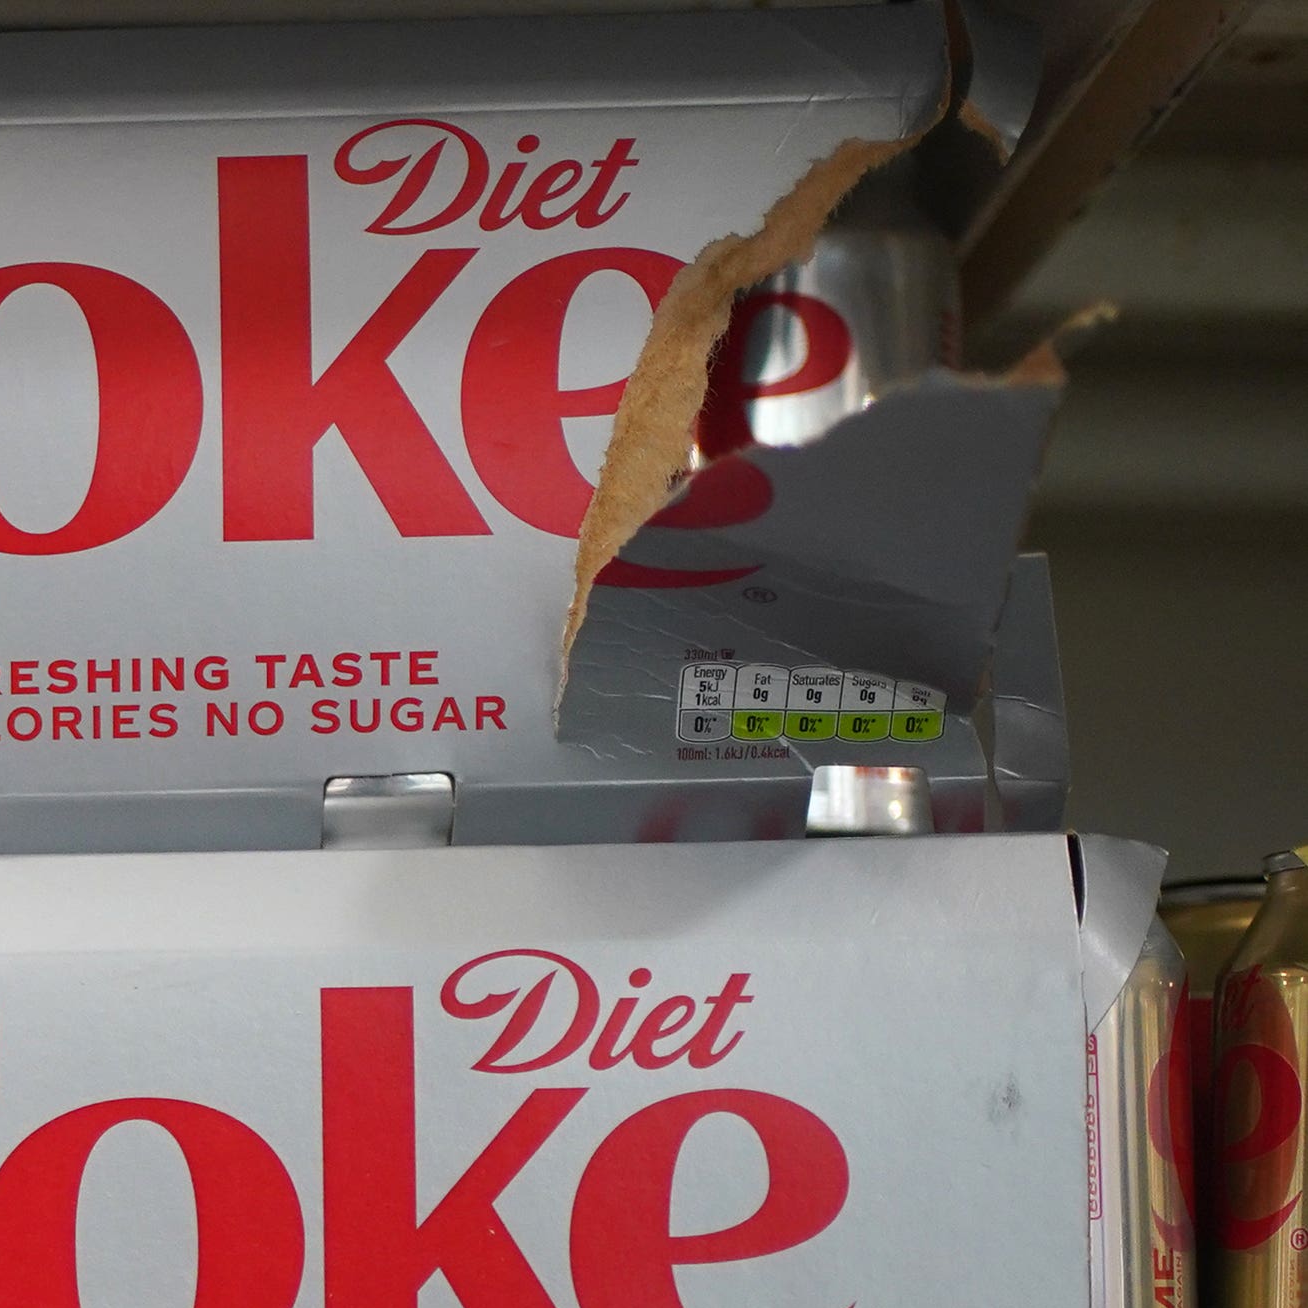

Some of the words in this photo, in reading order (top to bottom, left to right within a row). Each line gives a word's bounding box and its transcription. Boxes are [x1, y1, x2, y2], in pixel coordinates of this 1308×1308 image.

[334, 119, 638, 236] Diet
[683, 648, 718, 661] 330ml
[255, 651, 440, 690] TASTE
[694, 667, 727, 680] Energy
[754, 673, 771, 685] Fat
[792, 674, 840, 686] Saturates
[699, 681, 719, 693] 5kJ
[695, 693, 721, 706] 1kcal
[206, 701, 284, 737] NO
[311, 696, 508, 735] SUGAR
[439, 952, 750, 1074] Diet
